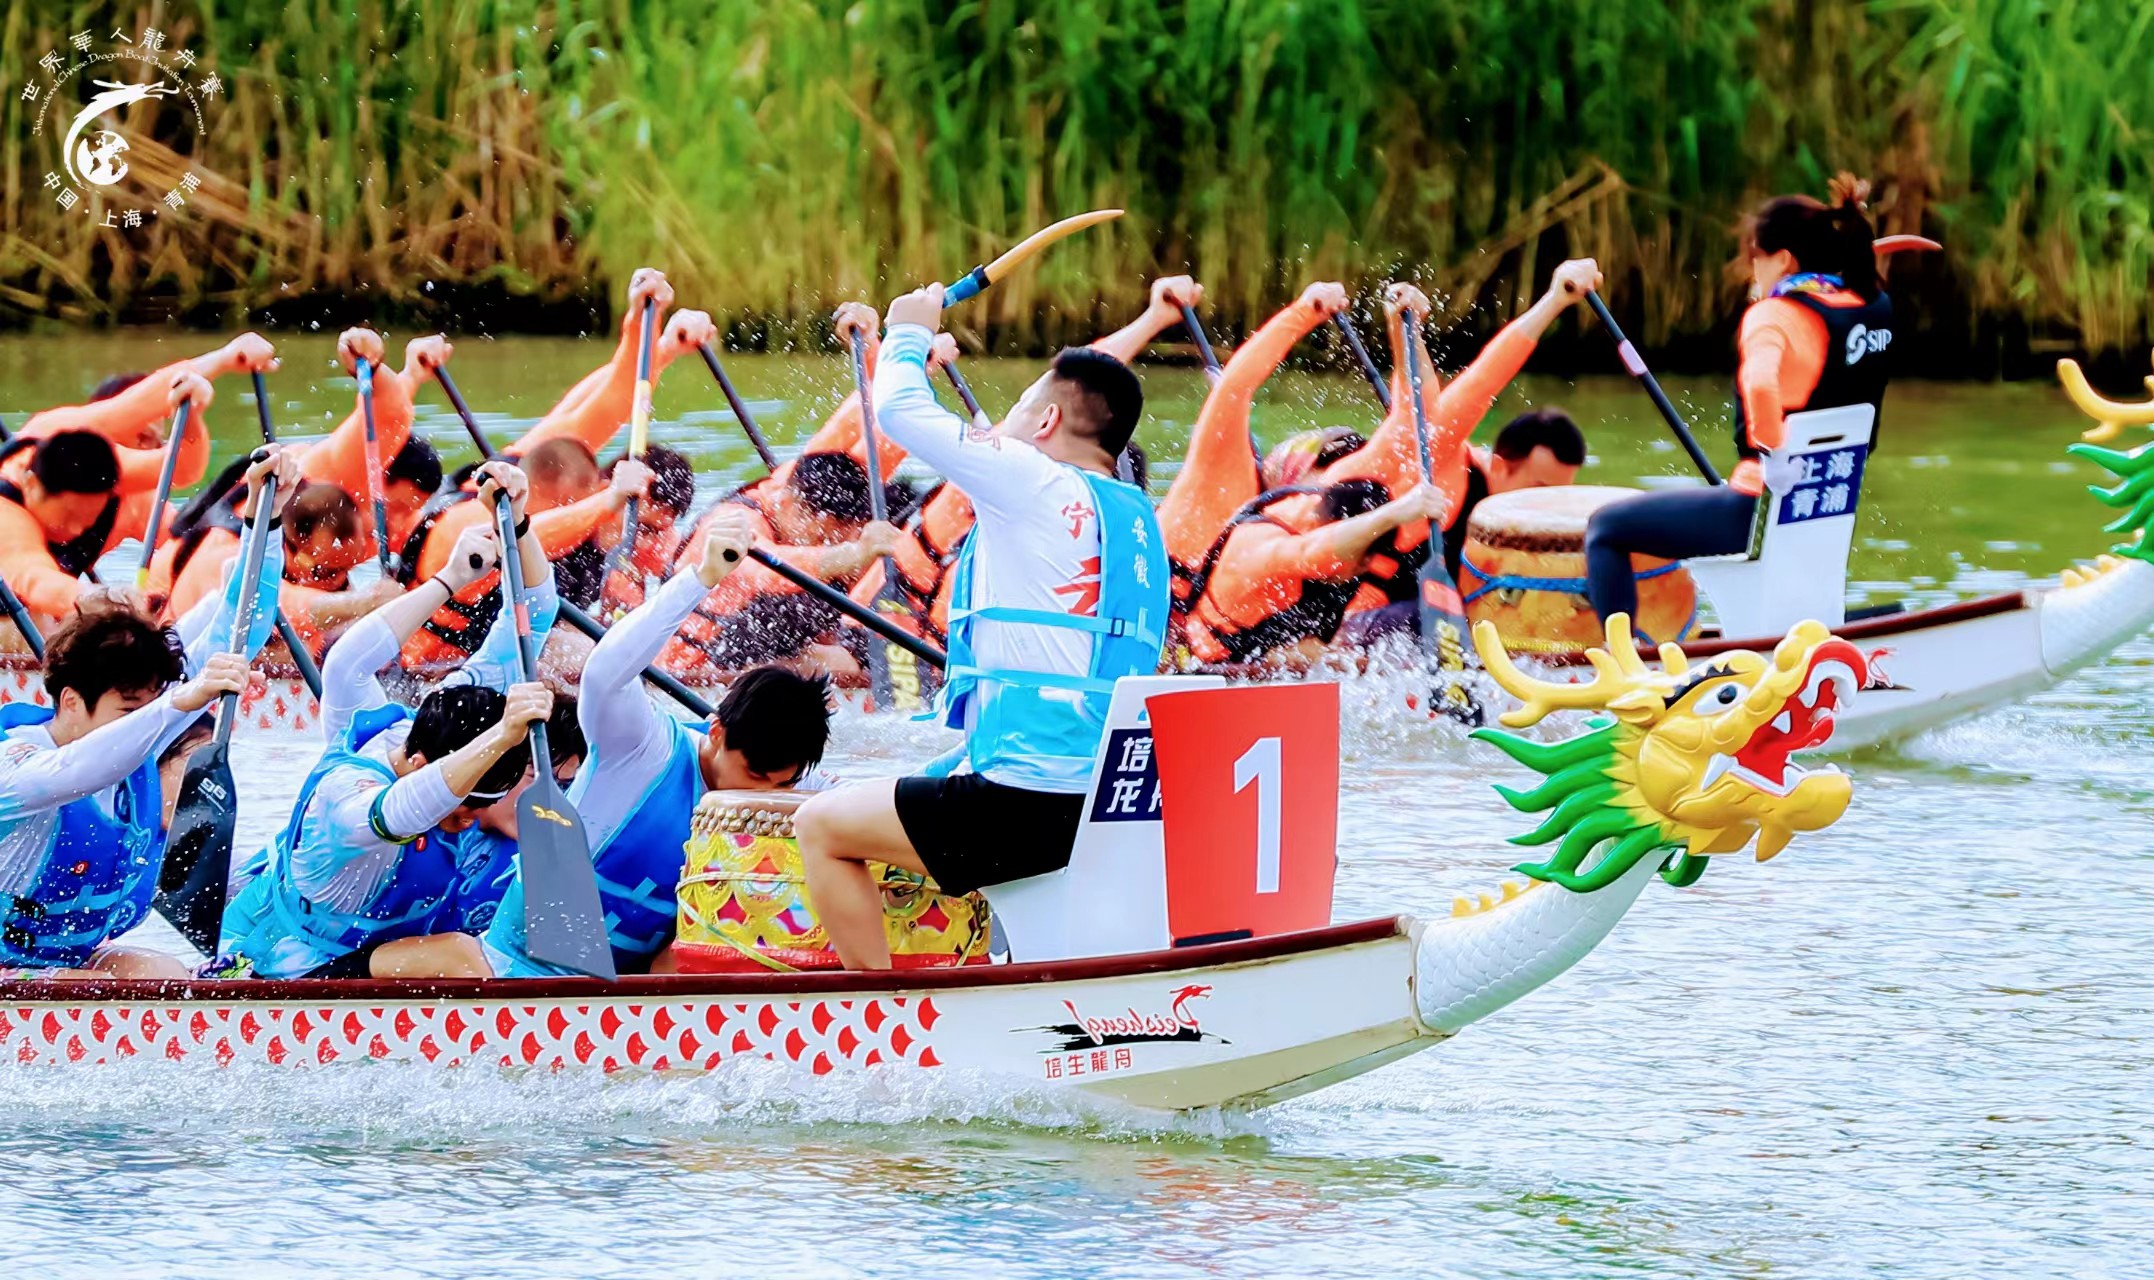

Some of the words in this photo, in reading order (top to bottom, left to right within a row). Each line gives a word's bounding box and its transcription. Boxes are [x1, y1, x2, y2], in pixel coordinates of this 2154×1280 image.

[1867, 329, 1892, 352] SIP
[1797, 451, 1855, 485] 上海
[1791, 483, 1850, 518] 青浦
[1233, 736, 1282, 894] 1
